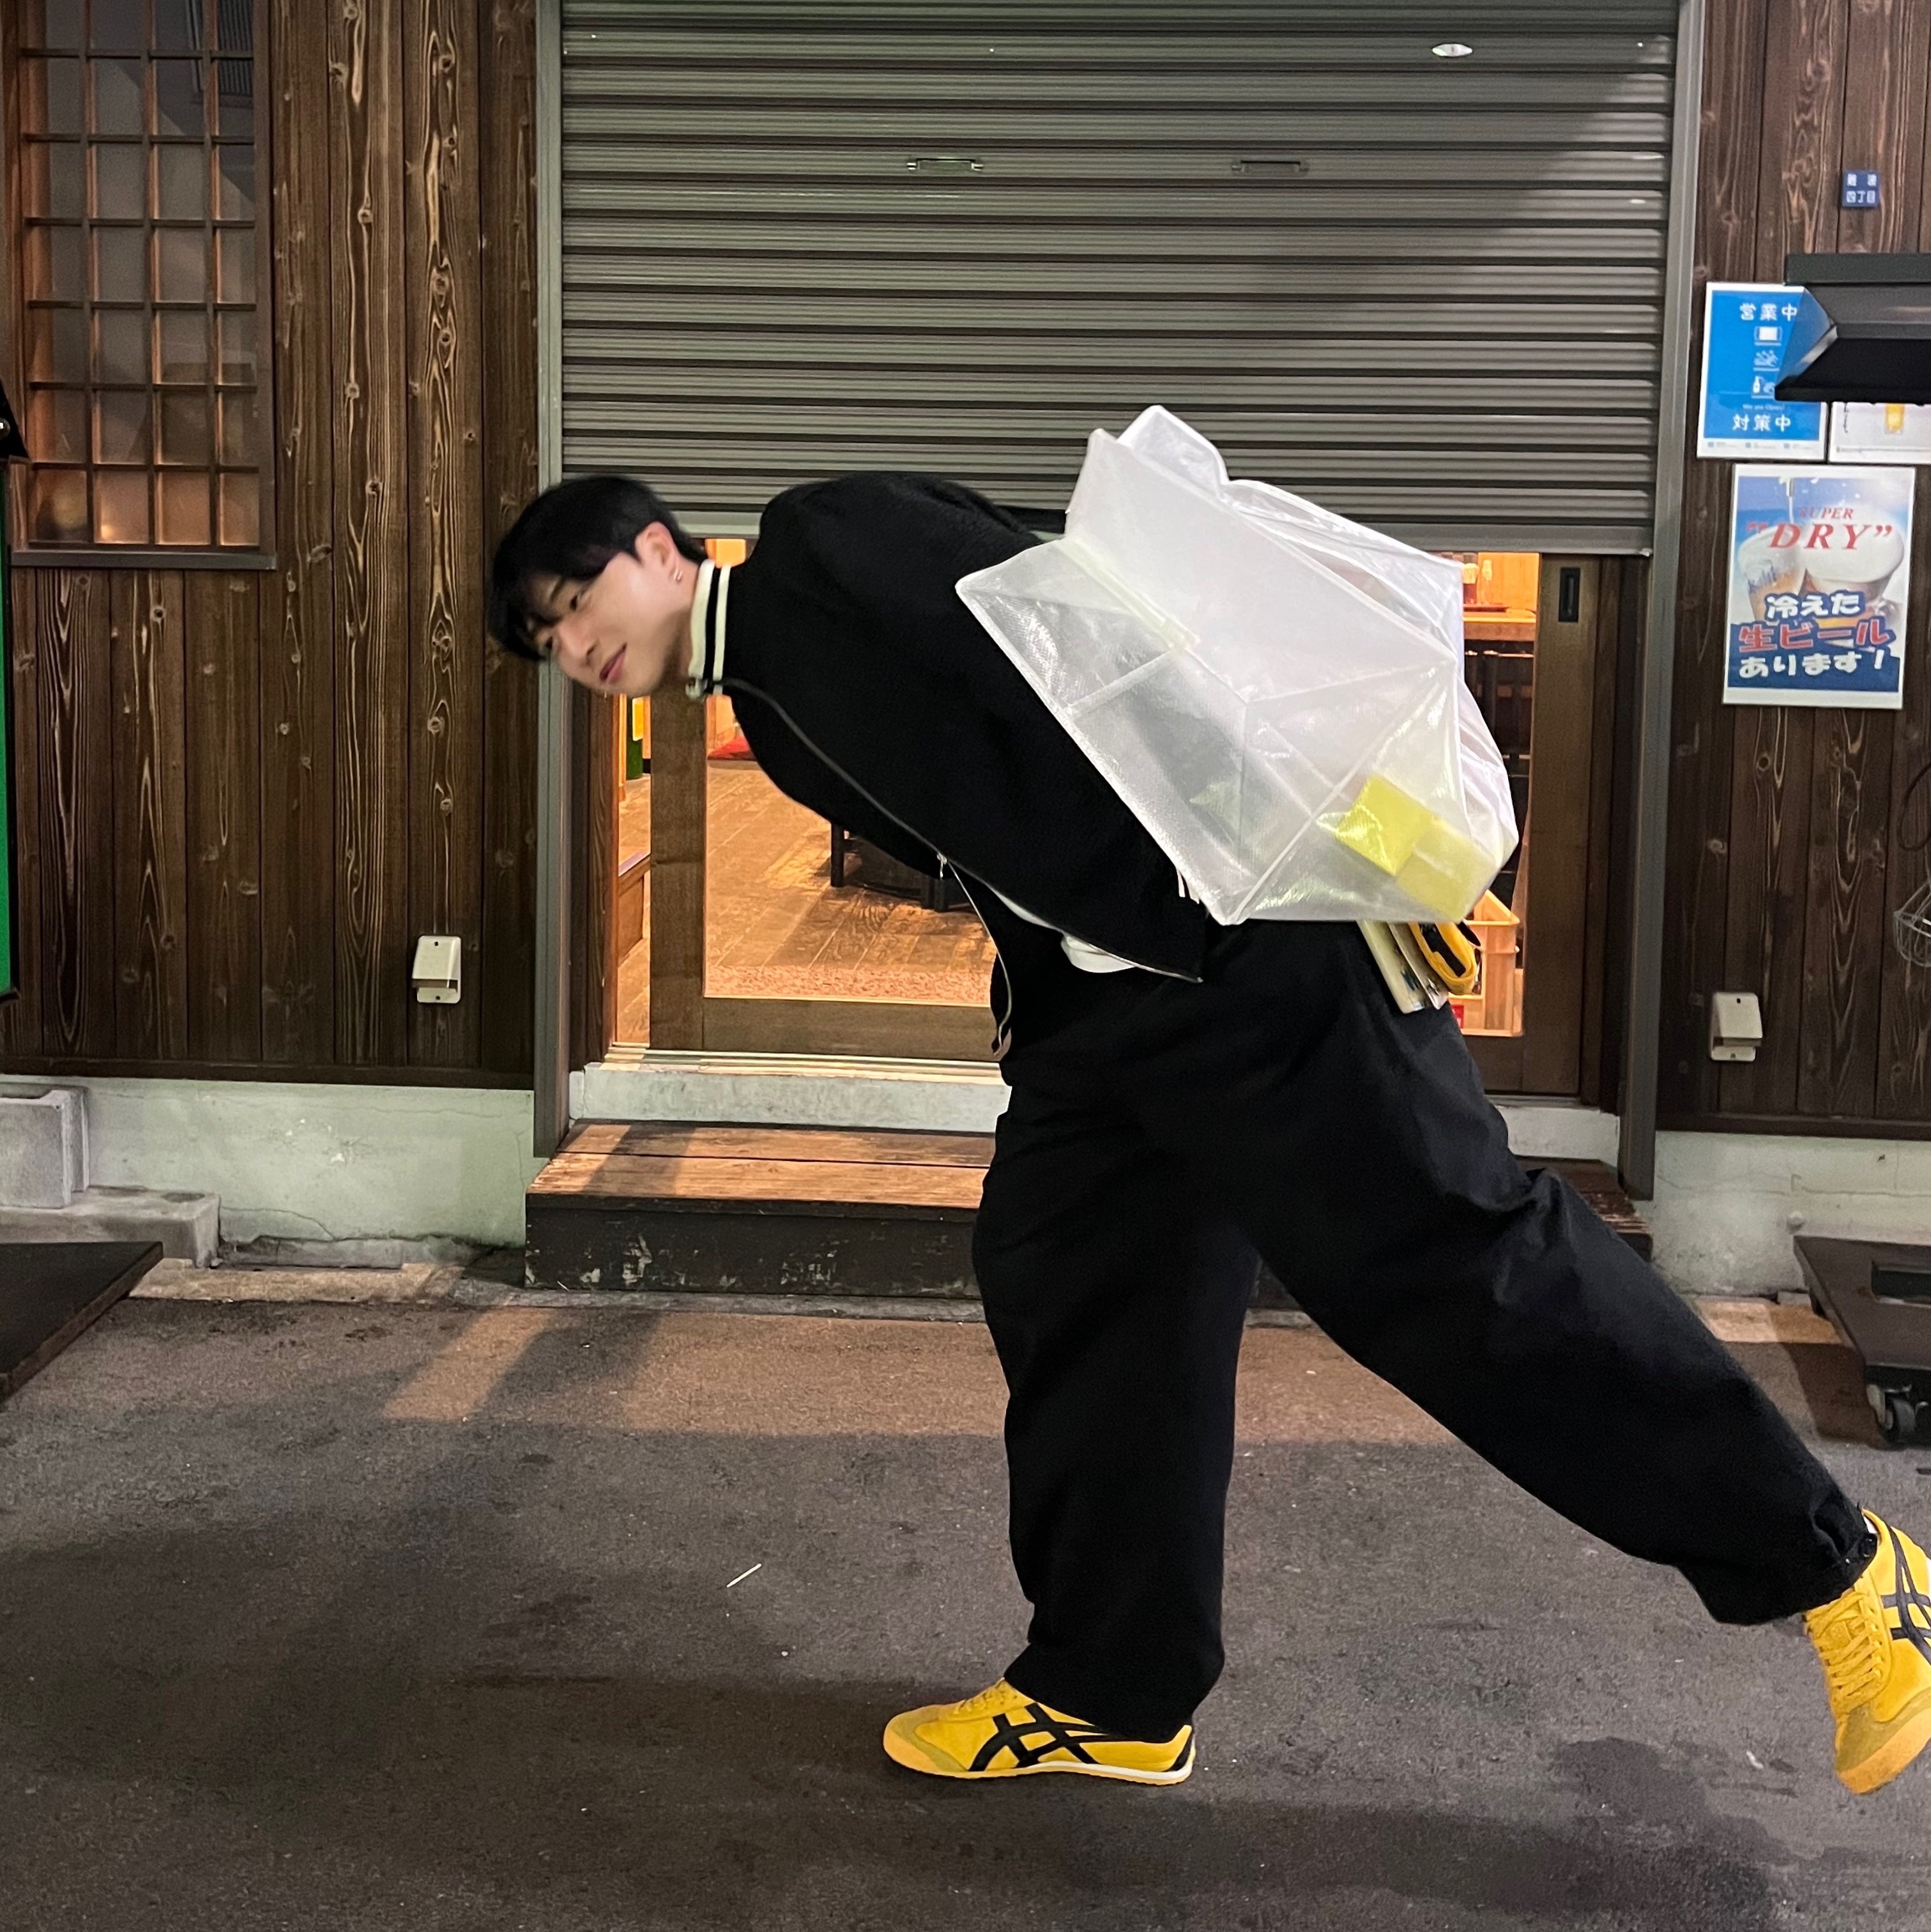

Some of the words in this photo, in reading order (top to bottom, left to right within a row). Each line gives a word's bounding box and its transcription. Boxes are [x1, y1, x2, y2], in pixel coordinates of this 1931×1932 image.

[1739, 303, 1797, 321] 営業中
[1732, 414, 1791, 432] 対策中
[1798, 506, 1854, 520] SUPER
[1766, 593, 1860, 619] 冷えた
[1739, 619, 1890, 653] 生ビール
